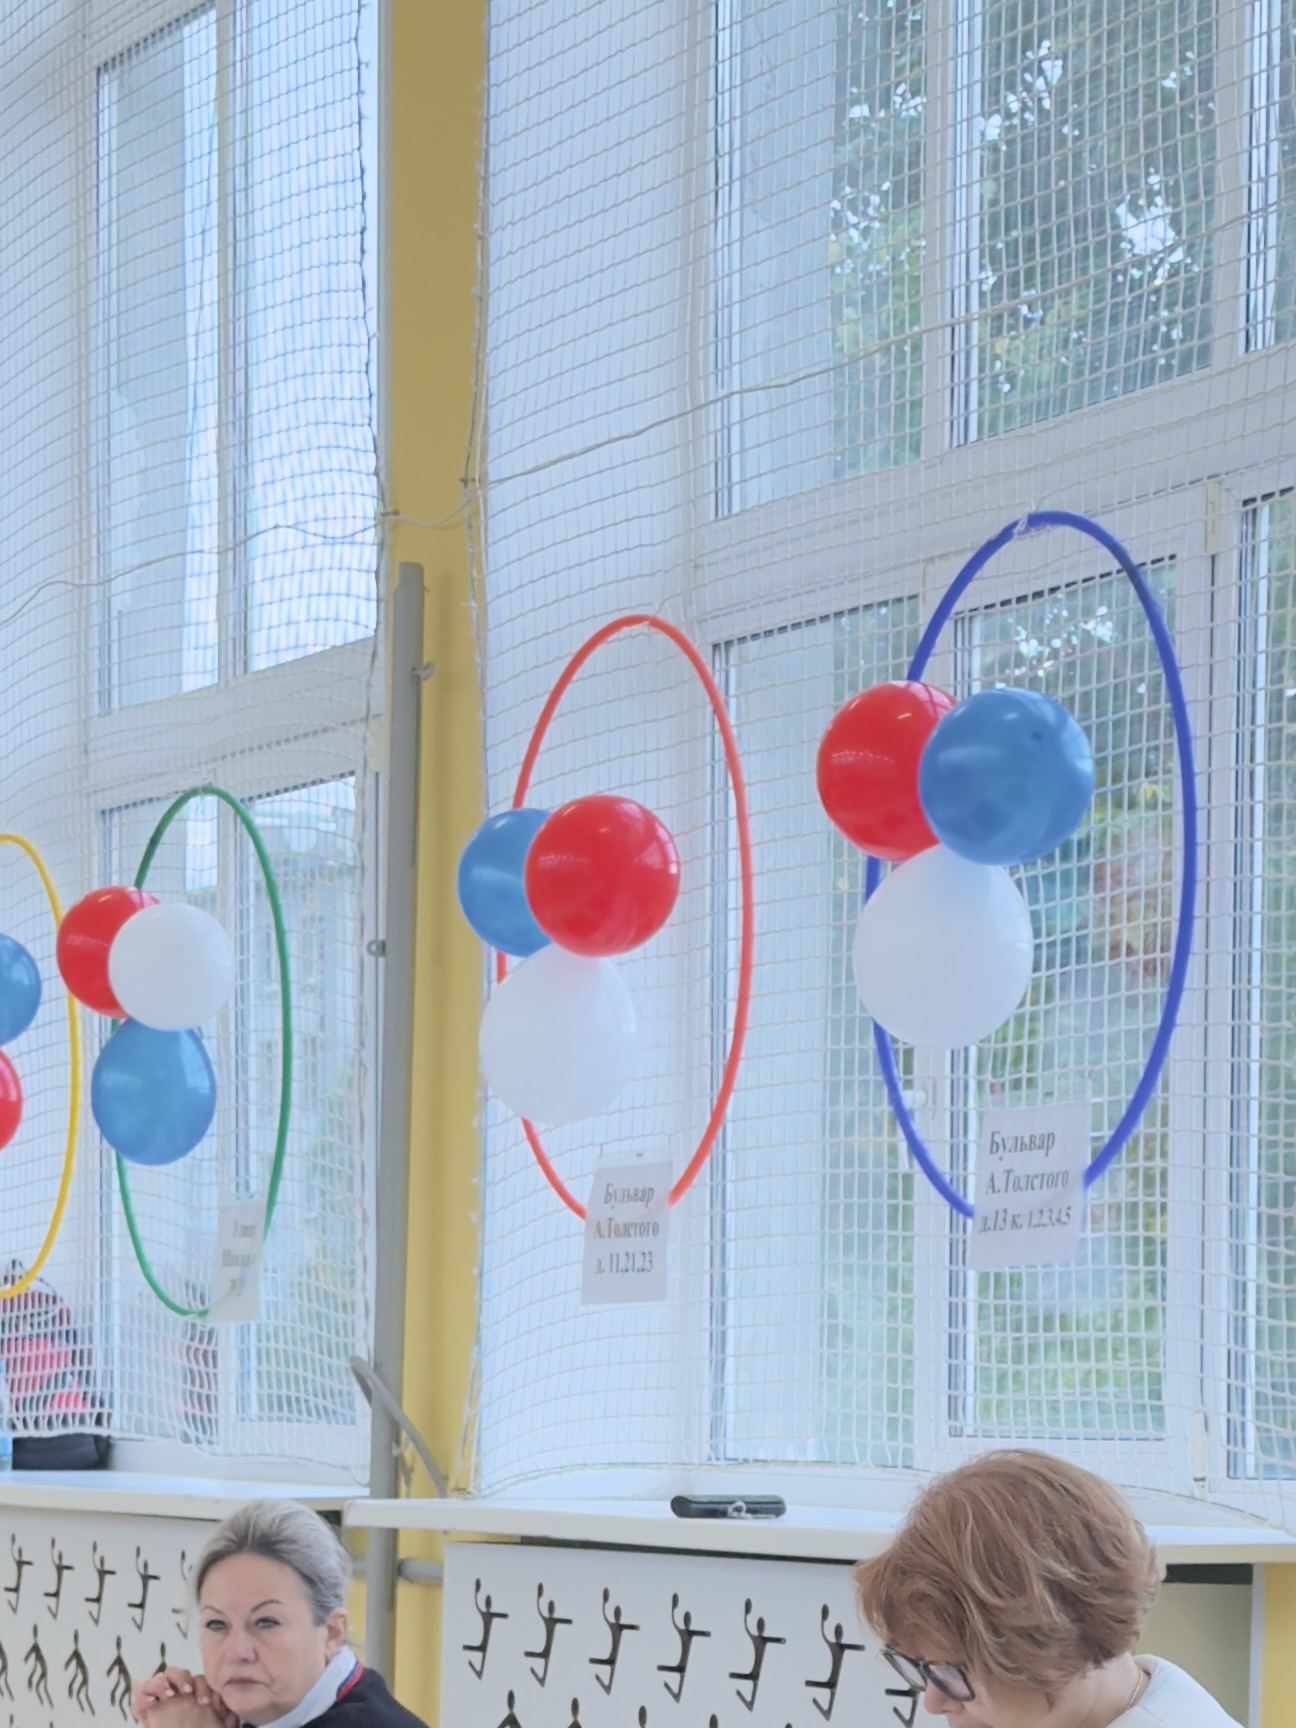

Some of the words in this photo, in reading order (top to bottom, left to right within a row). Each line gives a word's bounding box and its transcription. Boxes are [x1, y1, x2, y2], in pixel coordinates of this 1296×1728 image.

[989, 1131, 1055, 1161] Бульвар
[985, 1169, 1069, 1195] А.Толстого
[604, 1183, 654, 1210] Бульвар
